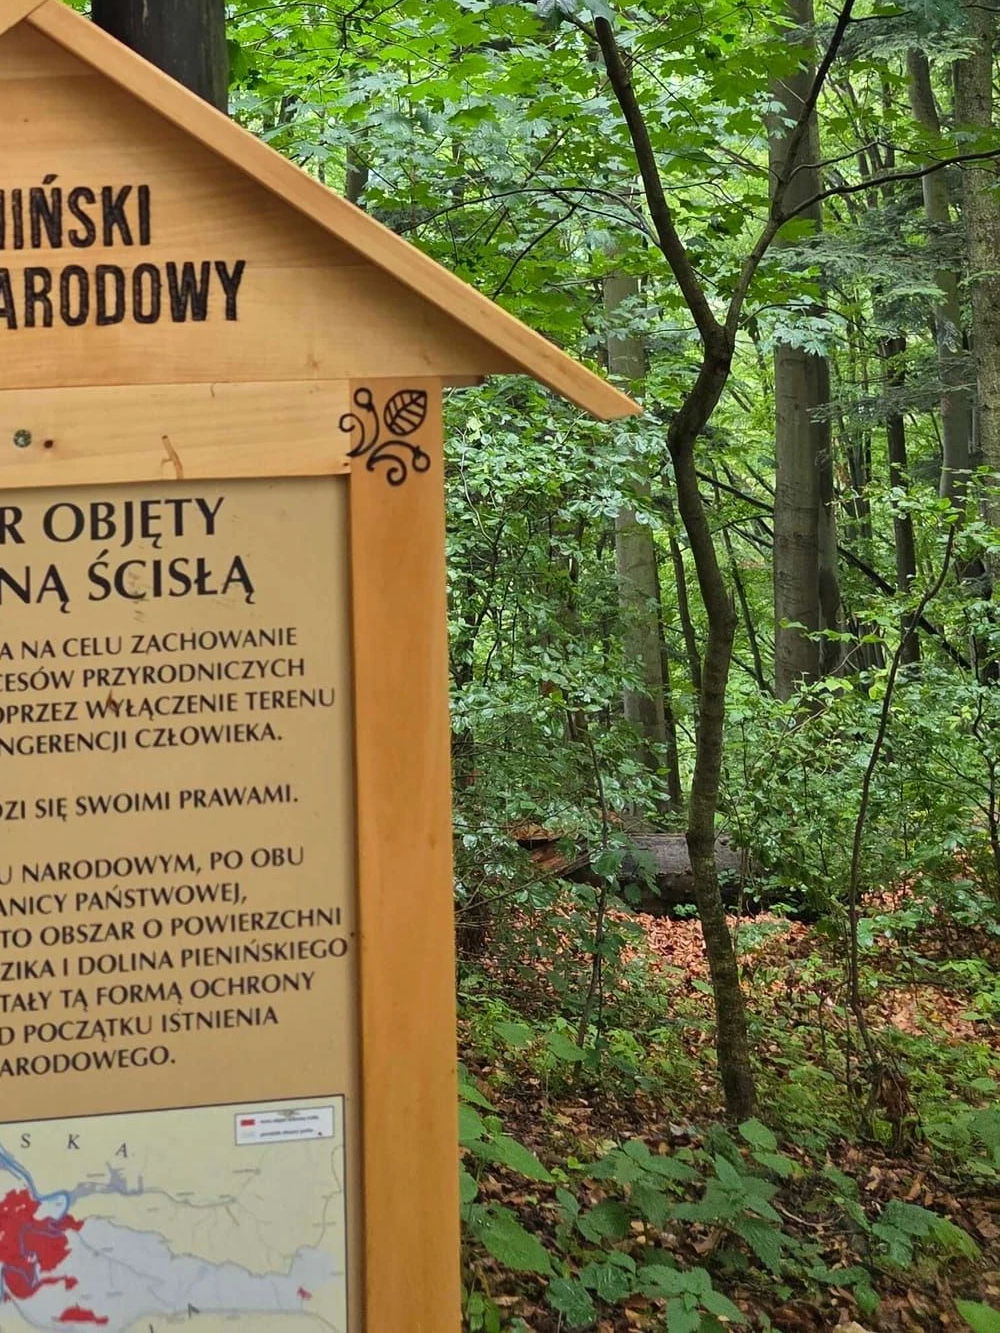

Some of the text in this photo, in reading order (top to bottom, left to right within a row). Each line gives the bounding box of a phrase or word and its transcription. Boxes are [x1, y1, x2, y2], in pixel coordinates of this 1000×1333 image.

[42, 497, 225, 548] OBJĘTY
[88, 549, 256, 604] ŚCISŁĄ
[21, 639, 56, 660] NA
[62, 635, 122, 658] CELU
[131, 627, 297, 655] ZACHOWANIE
[82, 658, 305, 688] PRZYRODNICZYCH
[85, 693, 238, 721] WYŁĄCZENIE
[245, 687, 336, 711] TERENU
[135, 722, 283, 749] CZŁOWIEKA.
[35, 797, 68, 822] SIĘ
[75, 792, 170, 816] SWOIMI
[179, 784, 299, 809] PRAWAMI.
[21, 853, 203, 883] NARODOWYM,
[210, 850, 243, 871] PO
[250, 846, 305, 868] OBU
[75, 882, 247, 911] PAŃSTWOWEJ,
[39, 921, 136, 947] OBSZAR
[143, 918, 162, 939] O
[170, 907, 342, 937] POWIERZCHNI
[78, 950, 174, 976] DOLINA
[181, 937, 348, 968] PIENIŃSKIEGO
[60, 988, 89, 1012] TĄ
[96, 981, 183, 1006] FORMĄ
[190, 971, 316, 999] OCHRONY
[23, 1015, 153, 1044] POCZĄTKU
